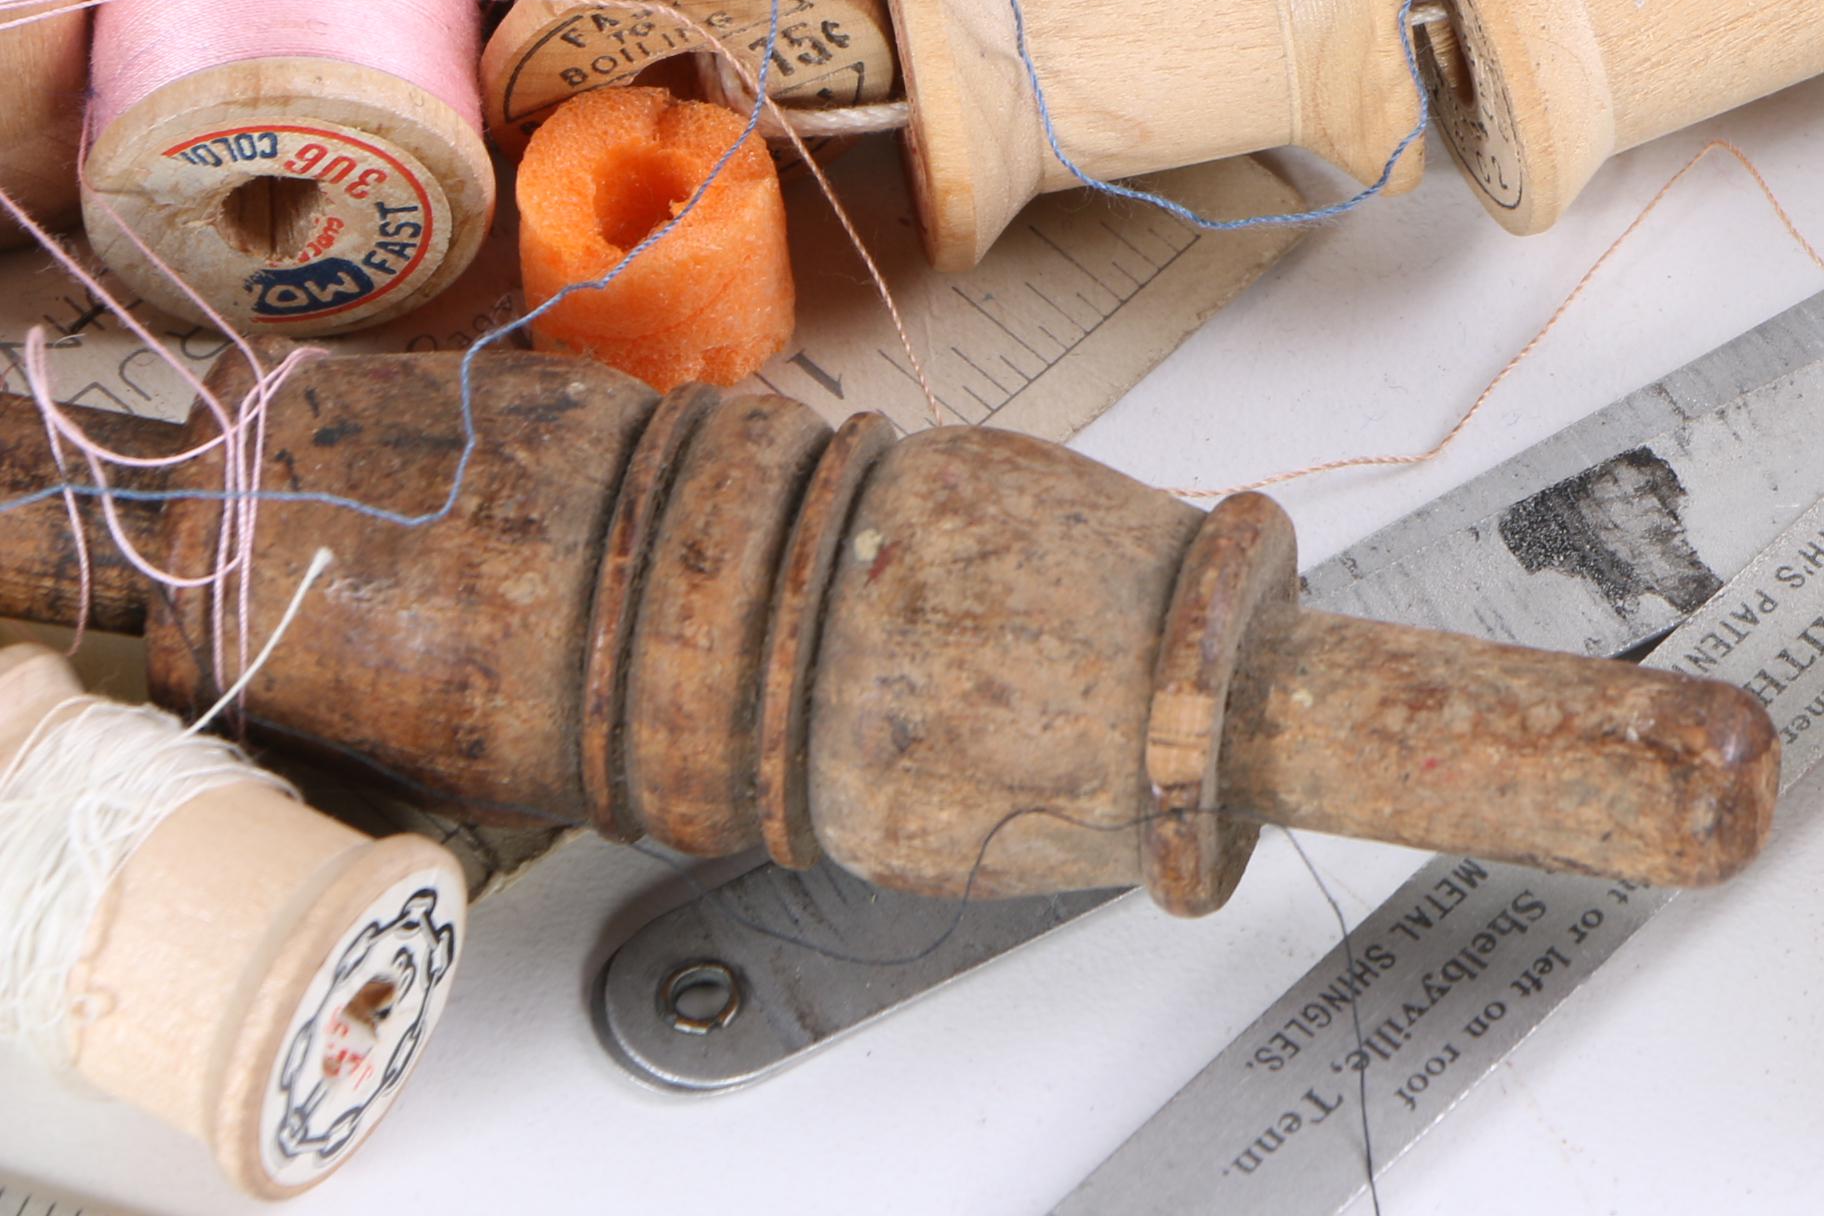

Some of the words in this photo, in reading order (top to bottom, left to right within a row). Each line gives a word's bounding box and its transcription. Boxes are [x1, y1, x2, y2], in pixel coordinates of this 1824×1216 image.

[361, 200, 421, 276] FAST
[1672, 588, 1780, 674] PATEN
[1389, 858, 1490, 942] METAL
[1568, 908, 1605, 946] or
[1245, 943, 1397, 1074] SHINGLES.
[1330, 889, 1548, 1075] Shelbyville,
[1510, 945, 1572, 998] left
[1463, 999, 1507, 1041] on
[1394, 1042, 1462, 1112] roof
[1221, 1086, 1344, 1178] Tenn.
